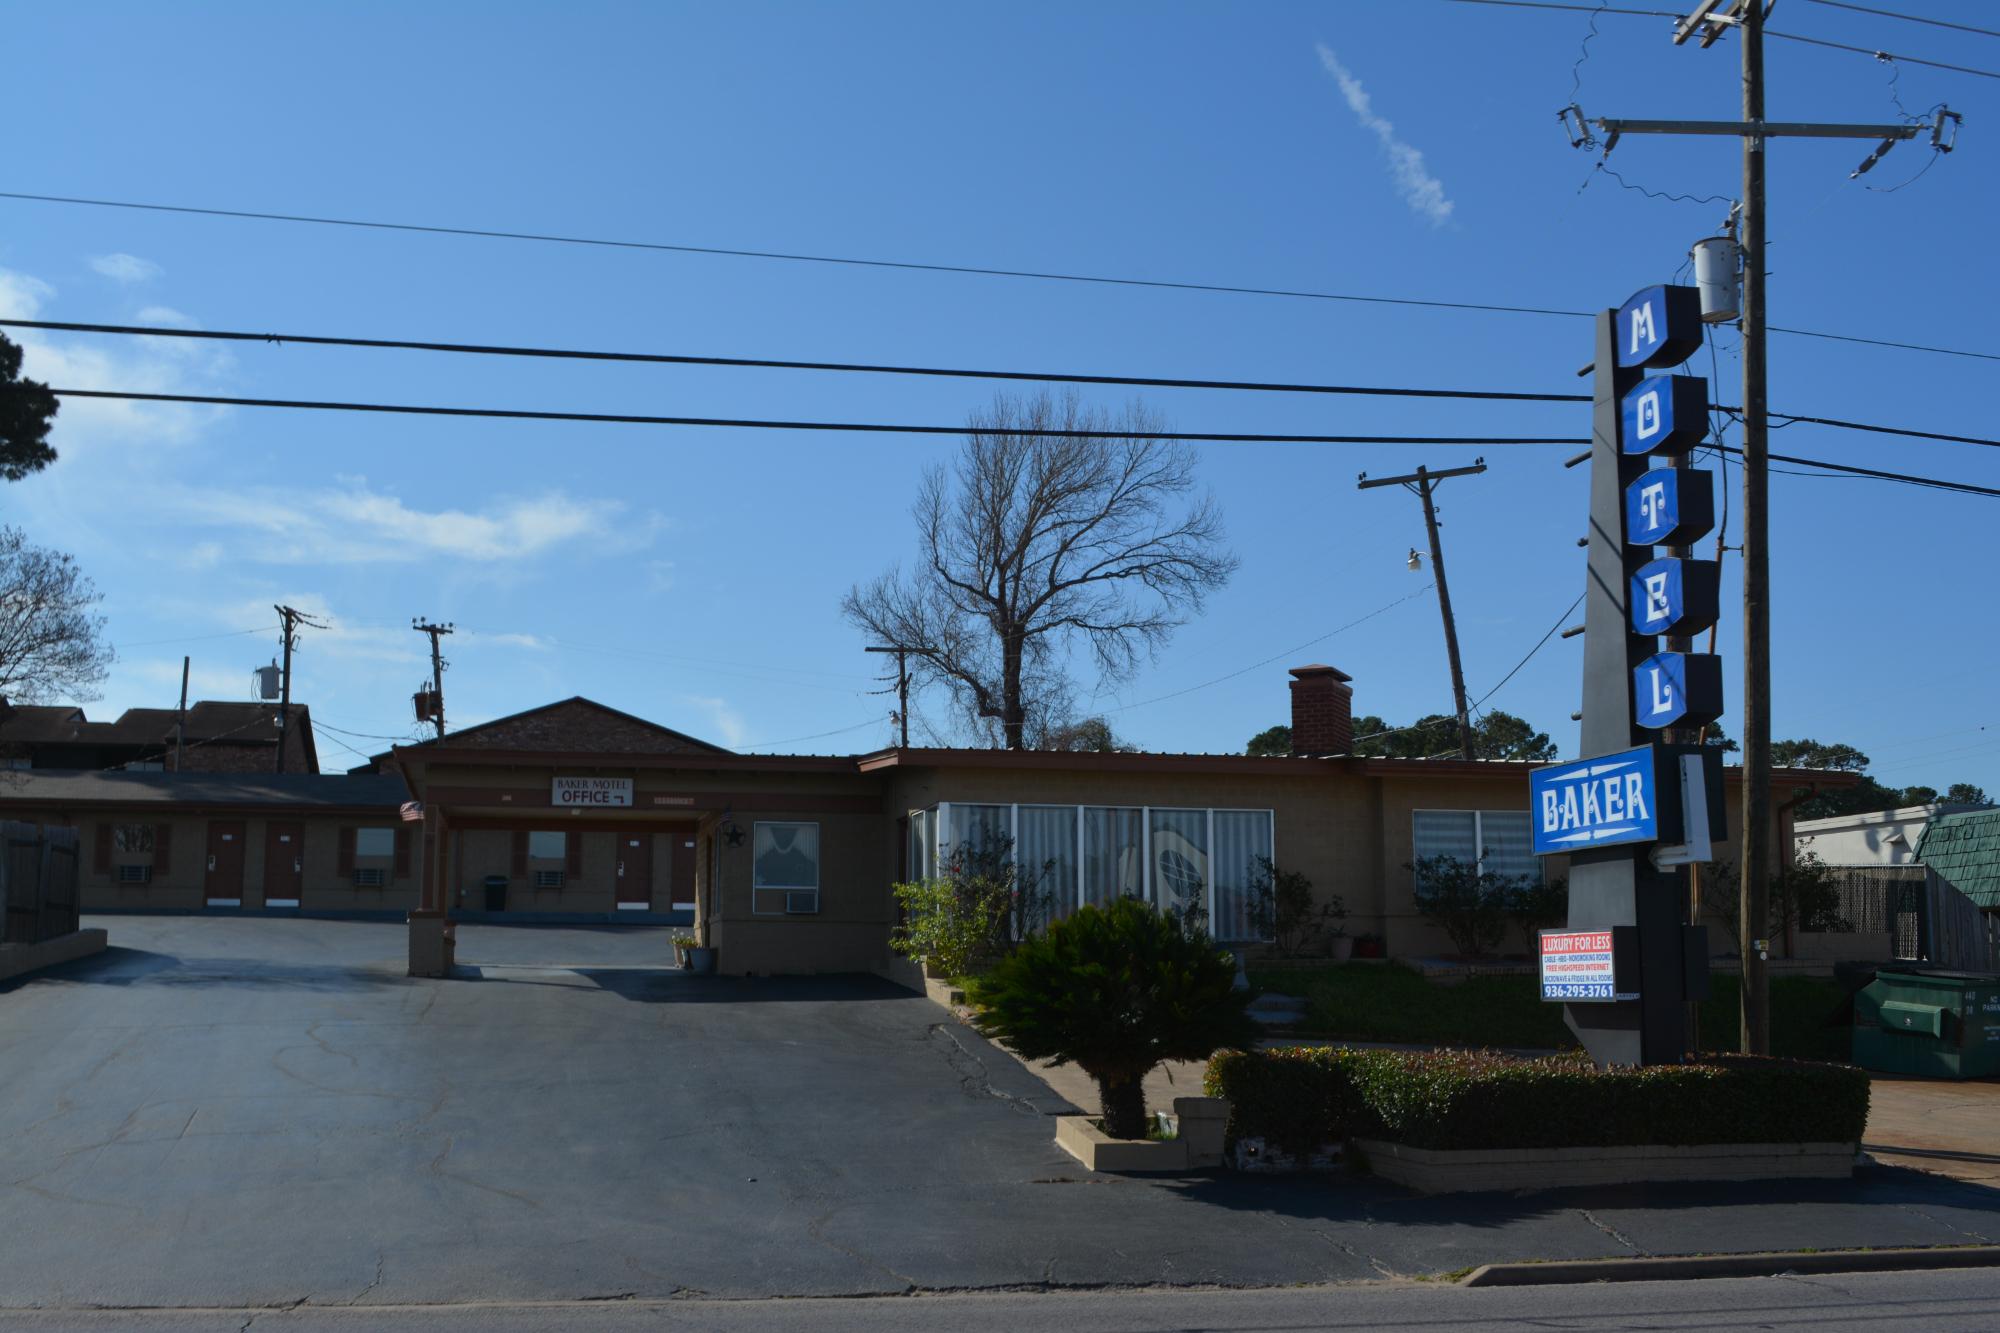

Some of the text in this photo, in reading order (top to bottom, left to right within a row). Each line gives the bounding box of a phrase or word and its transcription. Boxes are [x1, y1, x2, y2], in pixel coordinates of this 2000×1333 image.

[1630, 301, 1672, 714] MOTEL
[558, 780, 627, 789] BAKER MOTEL
[562, 790, 609, 803] OFFICE
[1541, 772, 1649, 833] BAKER
[1544, 935, 1610, 951] LUXURY FOR LESS
[1545, 984, 1613, 998] 936-295-3761
